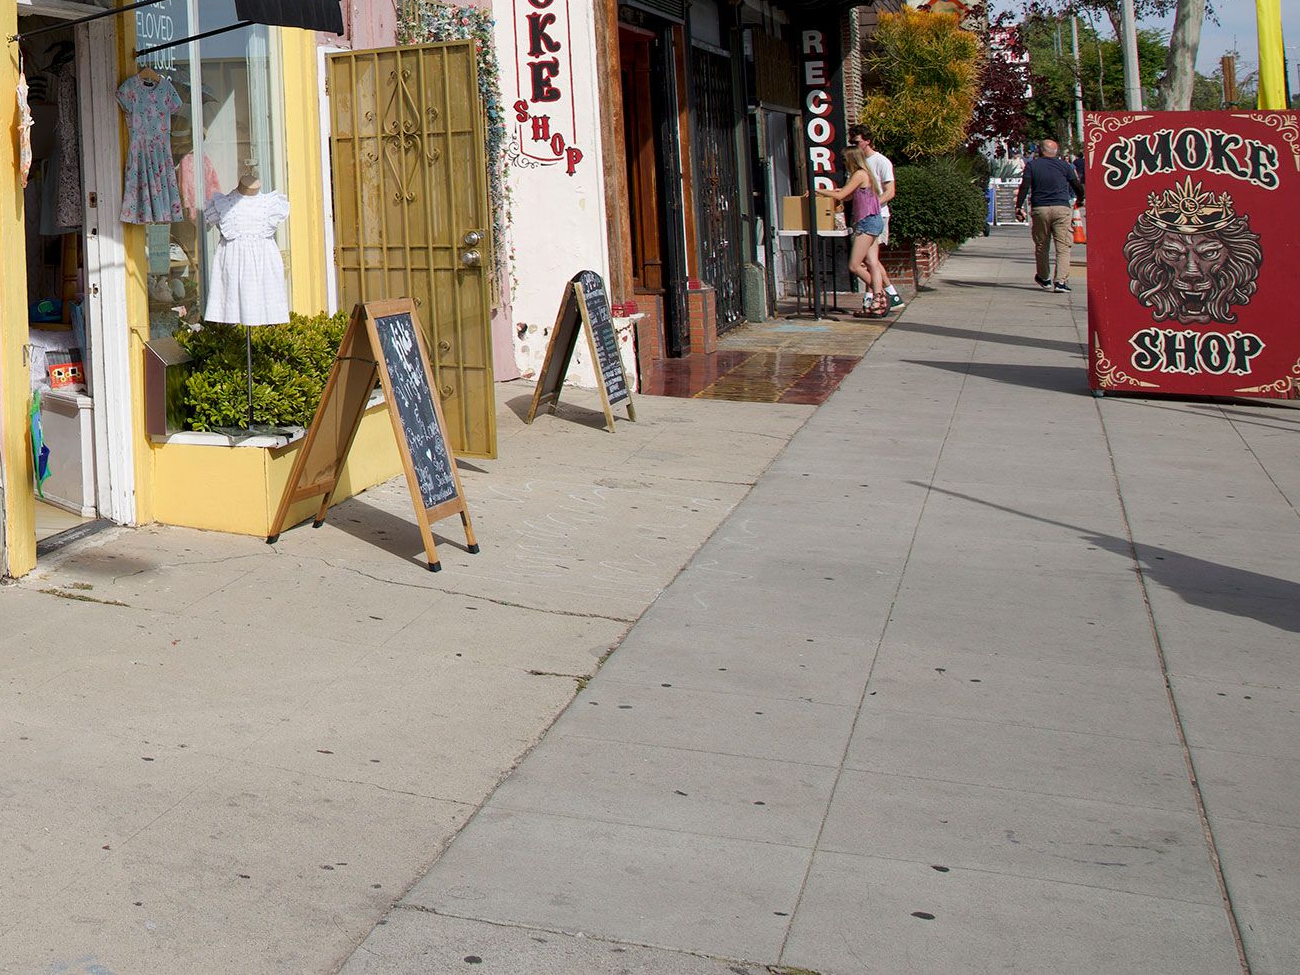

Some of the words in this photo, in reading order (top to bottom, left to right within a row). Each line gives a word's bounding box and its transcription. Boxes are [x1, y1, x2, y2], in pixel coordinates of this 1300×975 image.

[135, 11, 174, 41] ELOVED
[512, 99, 584, 177] SHOP
[1103, 127, 1280, 191] SMOKE
[1129, 327, 1265, 376] SHOP
